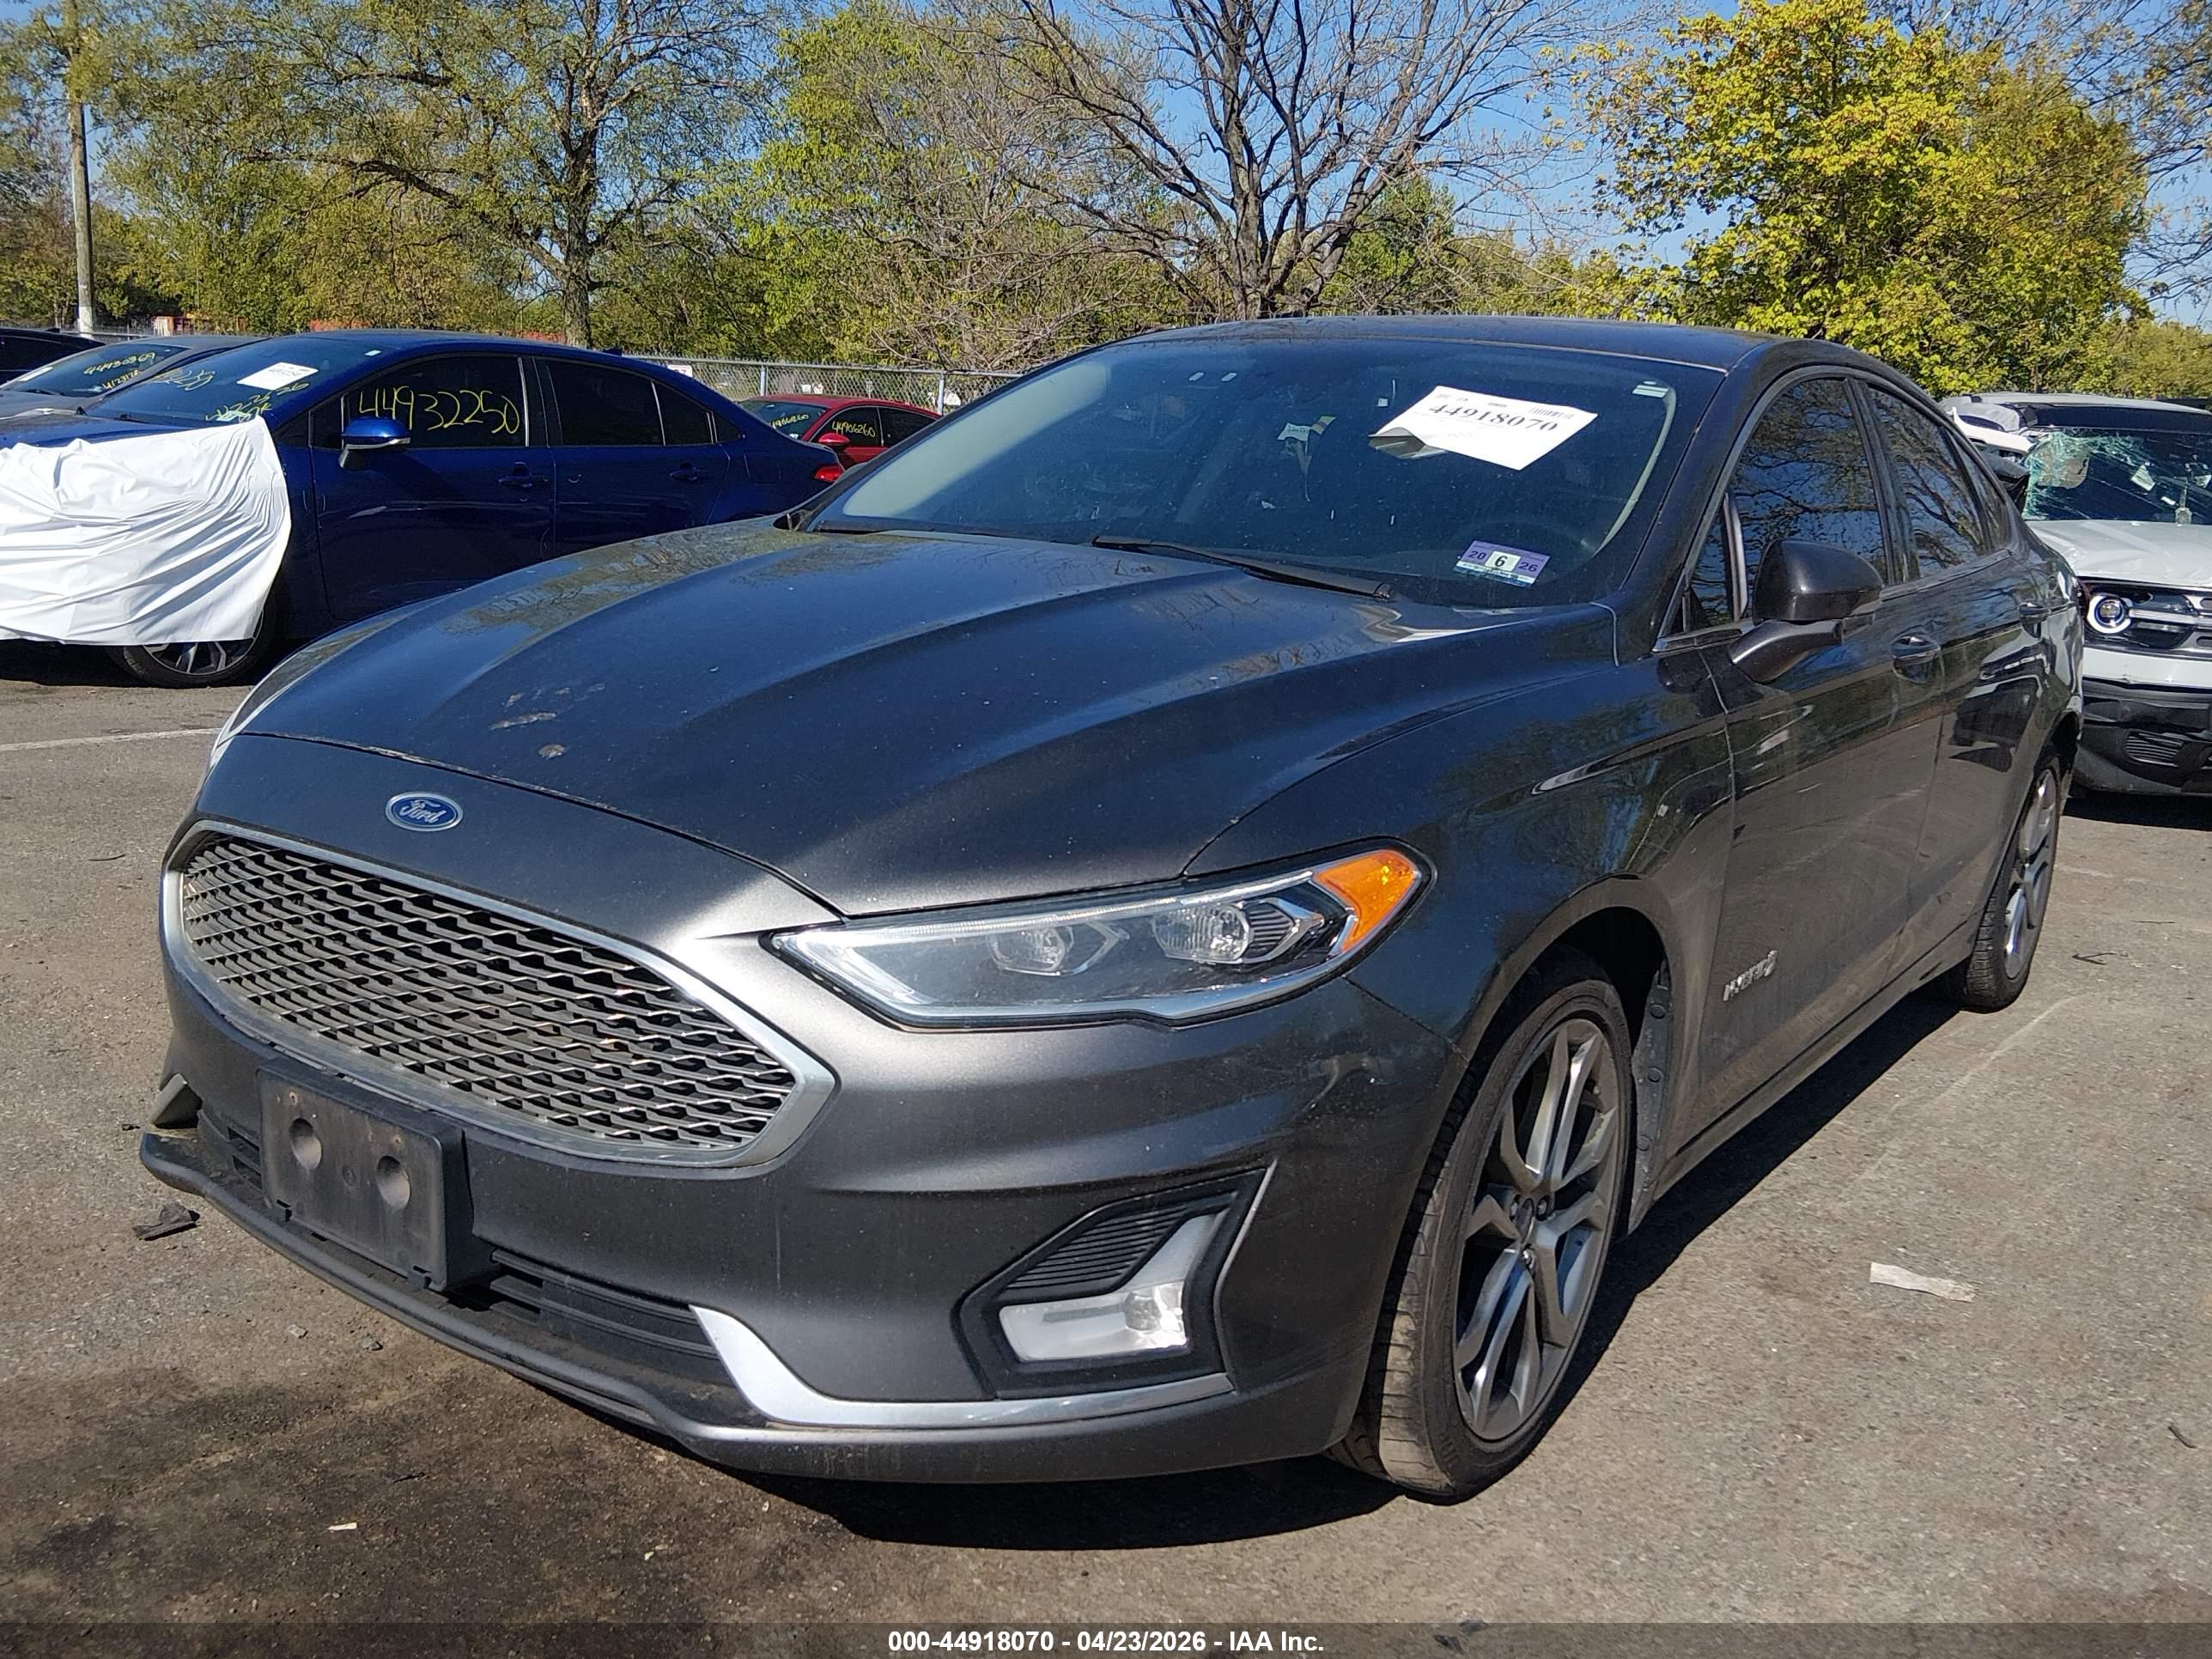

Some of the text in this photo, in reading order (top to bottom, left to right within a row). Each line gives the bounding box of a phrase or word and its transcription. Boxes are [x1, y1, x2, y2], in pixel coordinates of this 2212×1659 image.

[359, 386, 520, 434] 44932250
[1429, 404, 1559, 431] 44918070
[831, 420, 876, 438] 44906260
[1468, 550, 1487, 561] 20
[1494, 555, 1509, 568] 6
[1517, 562, 1539, 573] 26
[399, 799, 447, 823] Ford
